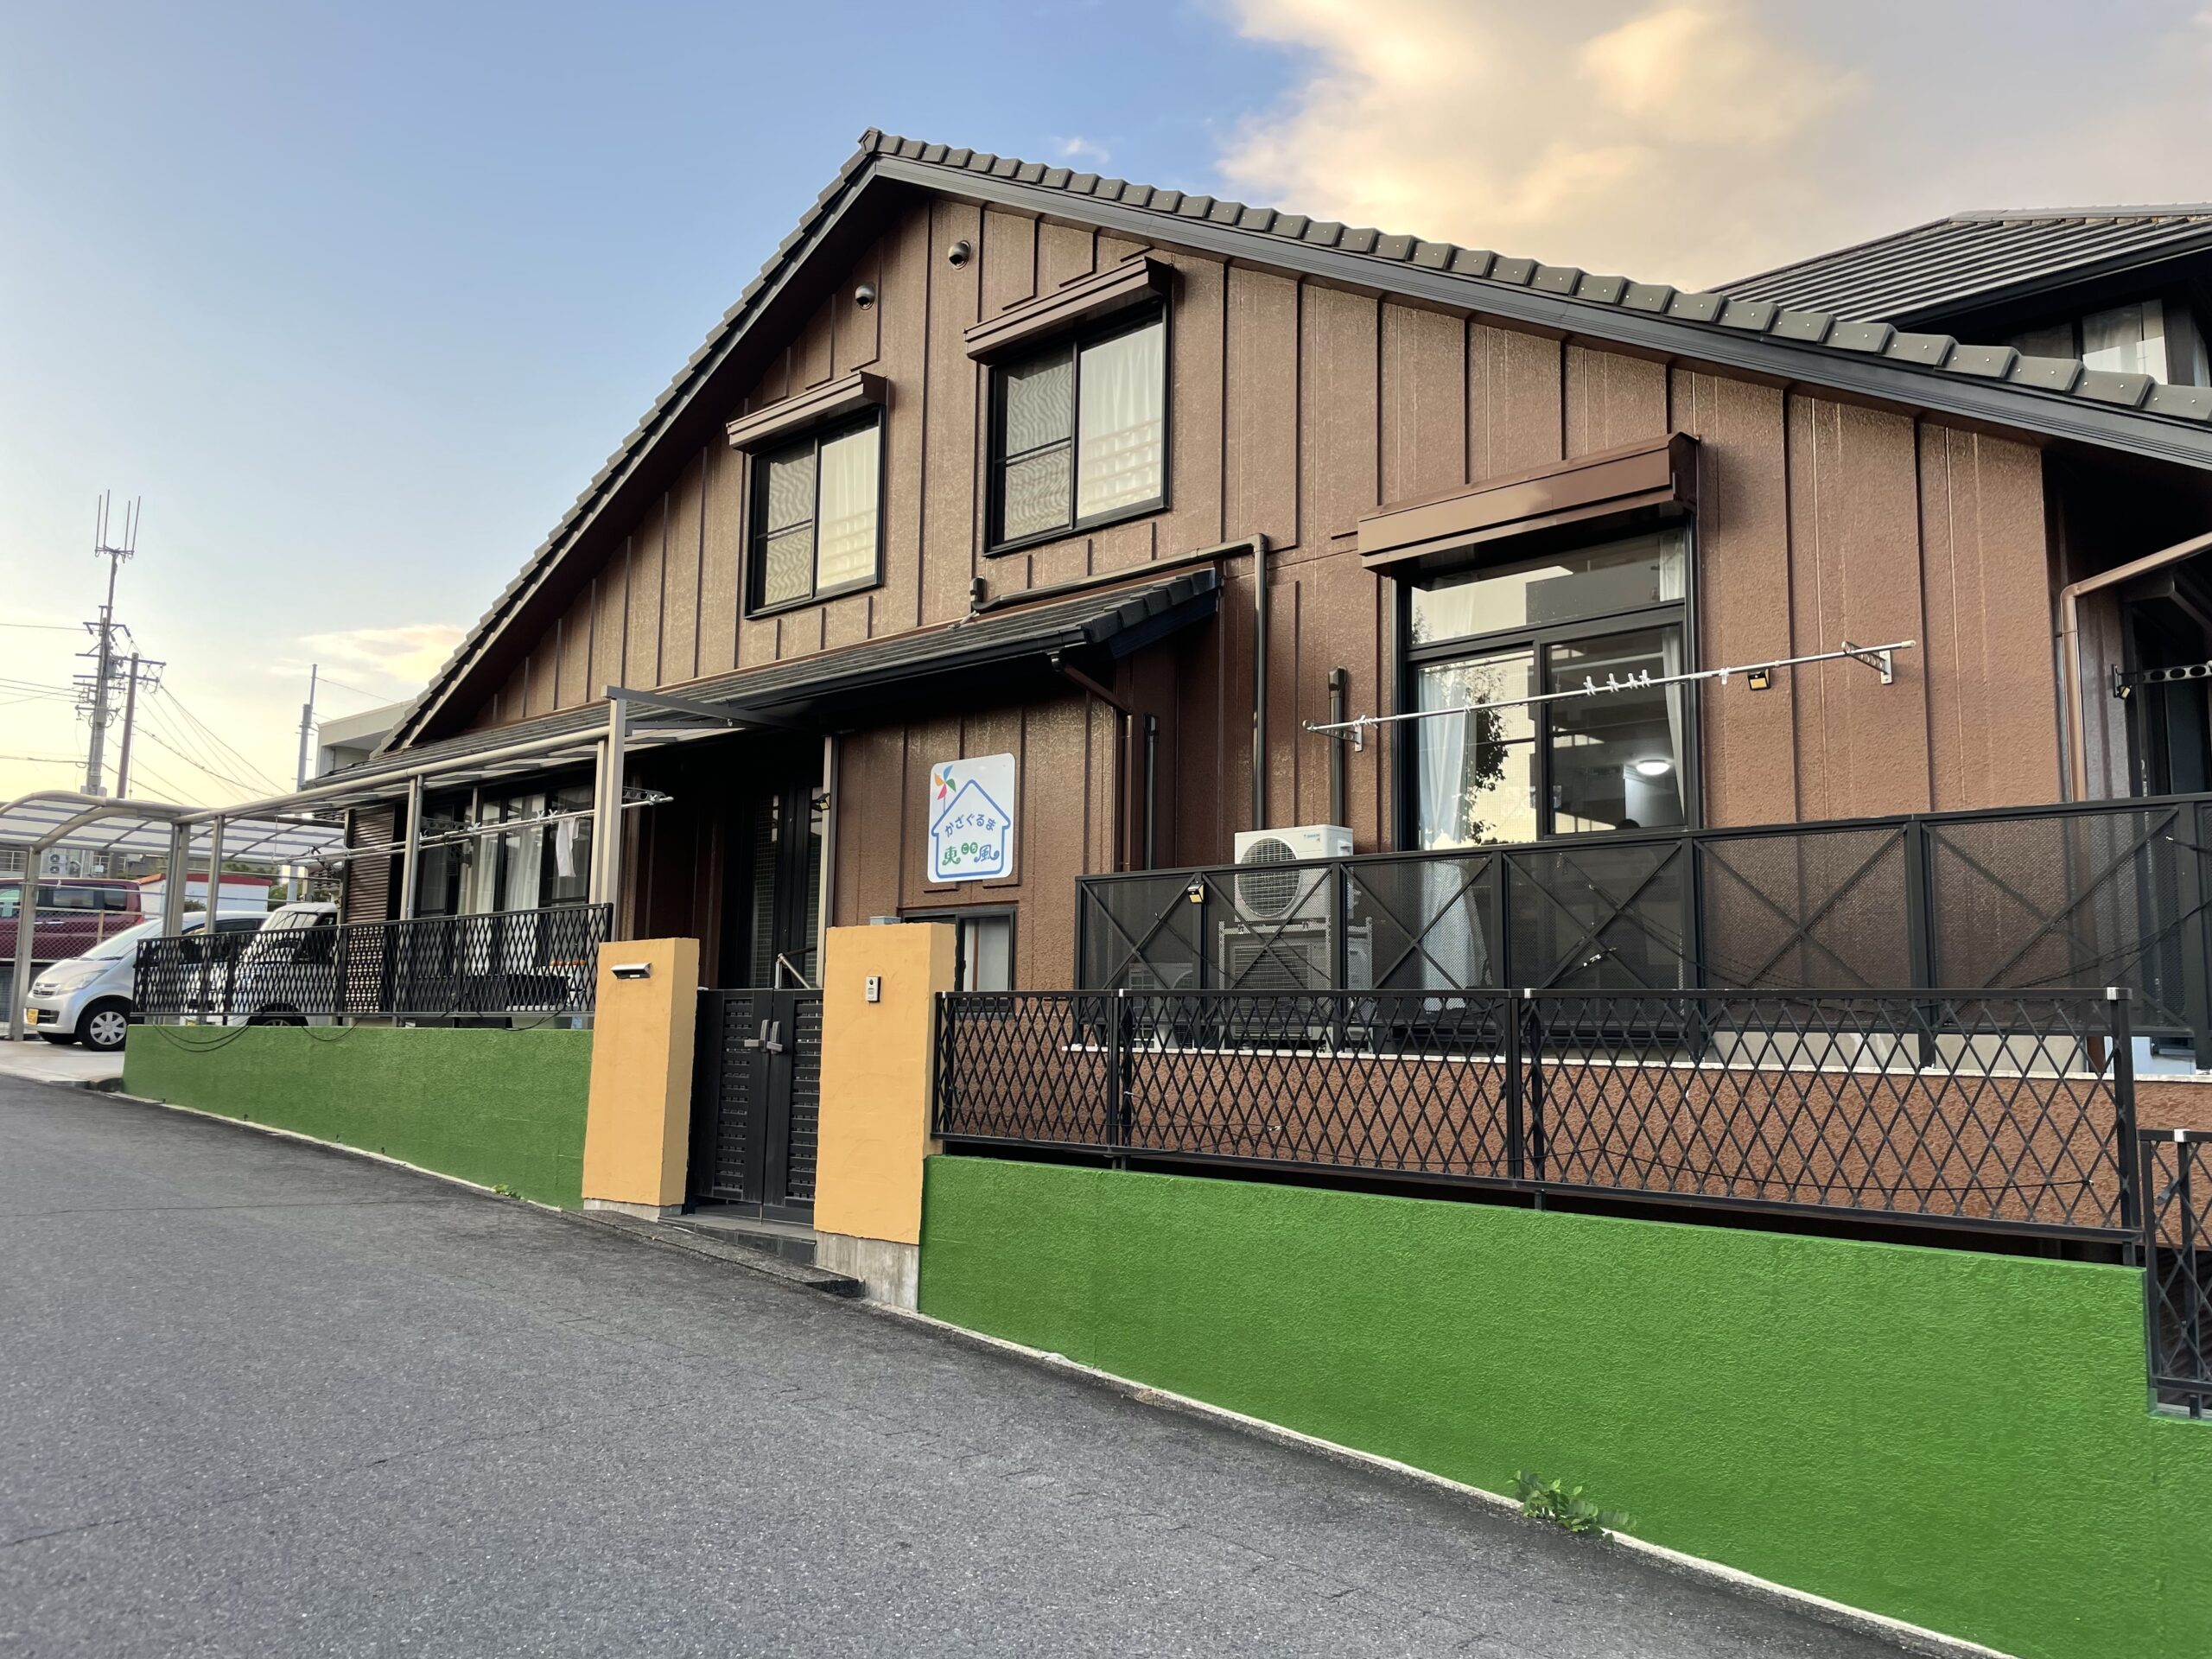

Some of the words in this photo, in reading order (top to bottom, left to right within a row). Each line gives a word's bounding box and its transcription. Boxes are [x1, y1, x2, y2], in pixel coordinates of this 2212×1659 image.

[944, 813, 996, 837] かざぐるま
